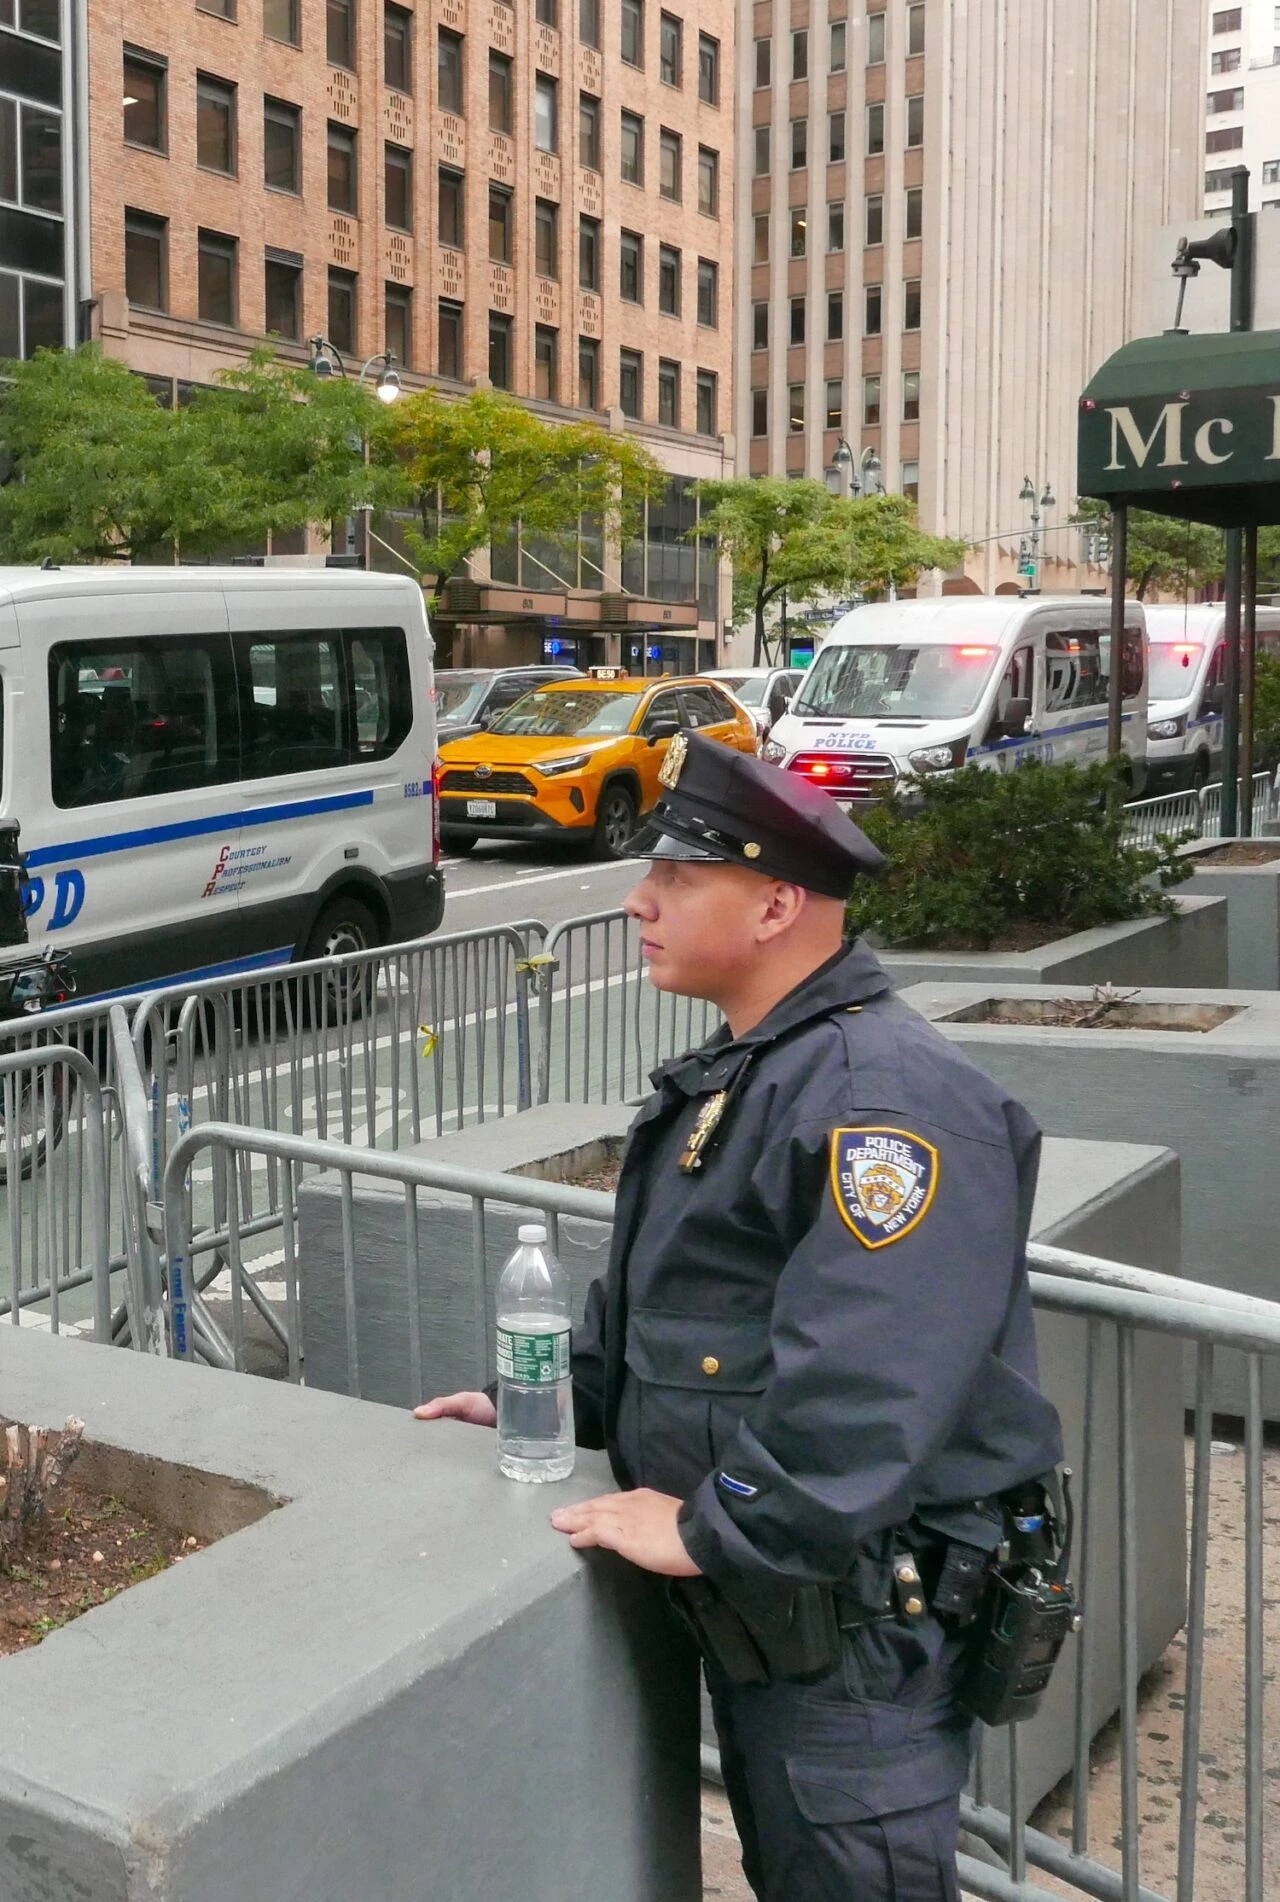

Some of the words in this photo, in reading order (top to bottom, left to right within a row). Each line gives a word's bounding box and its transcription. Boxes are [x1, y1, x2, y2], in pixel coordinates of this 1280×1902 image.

[1103, 402, 1234, 471] Mc
[814, 738, 878, 750] POLICE
[219, 845, 268, 863] COURTESY
[211, 856, 292, 881] PROFESSIONALISM
[201, 881, 246, 899] RESPECT
[865, 1136, 912, 1158] POLICE
[845, 1147, 926, 1178] DEPARTMENT
[841, 1172, 857, 1199] CITY
[849, 1203, 866, 1219] OF
[882, 1212, 908, 1234] NEW
[902, 1185, 927, 1215] YORK
